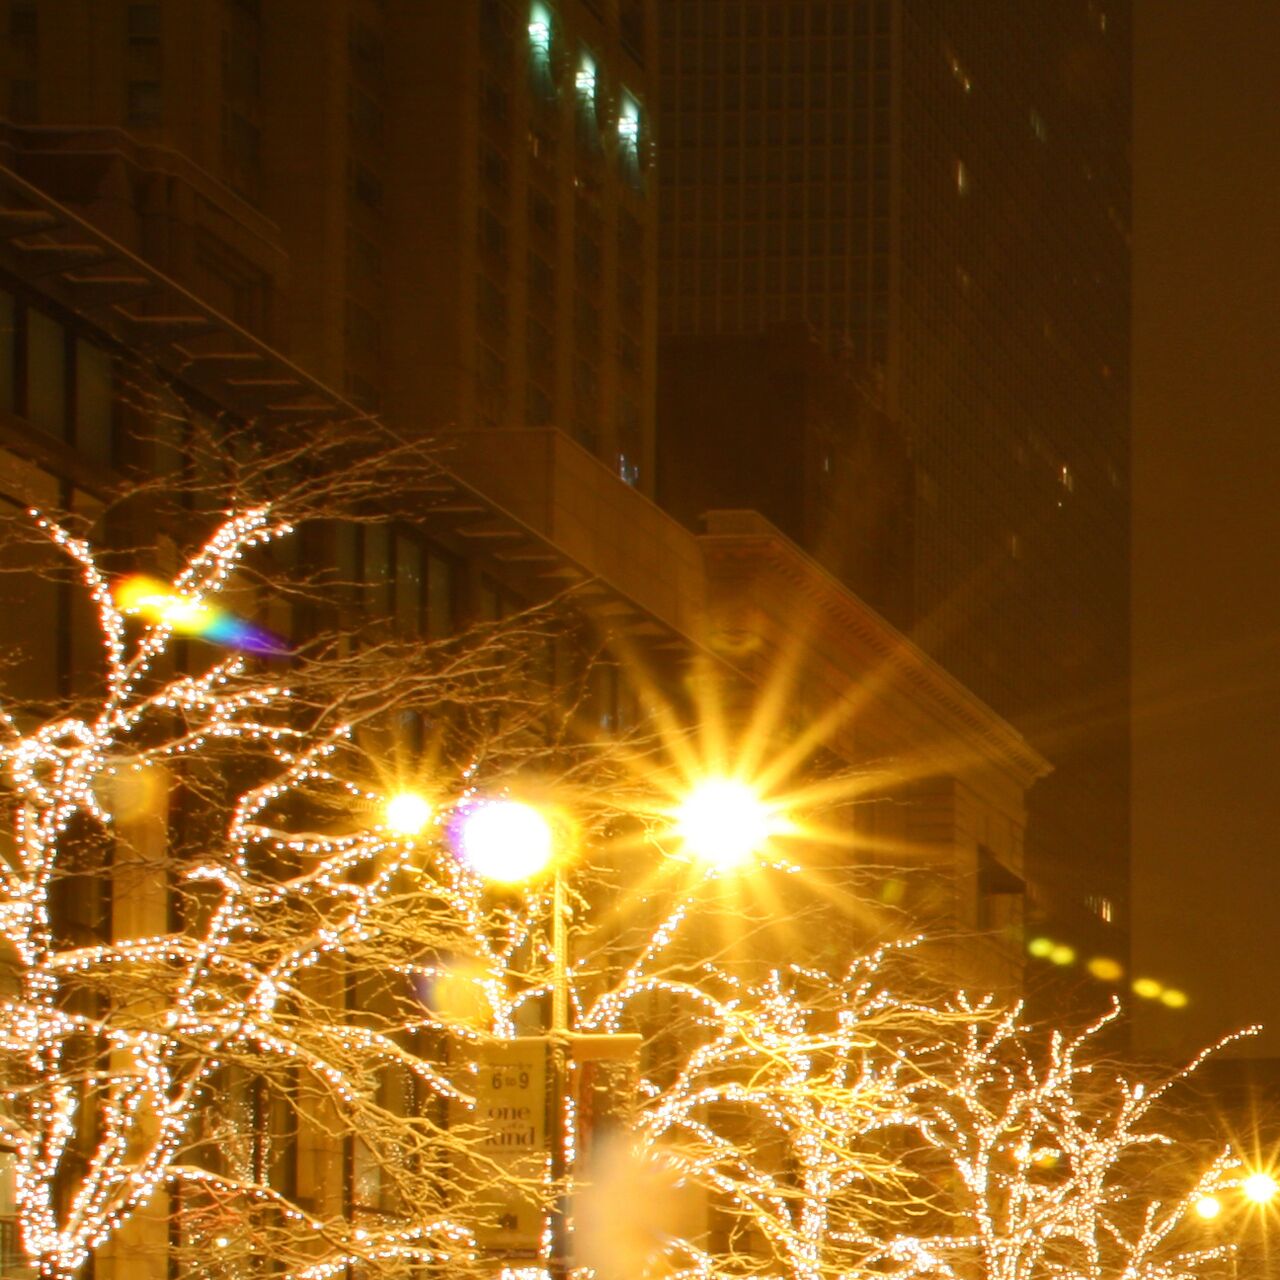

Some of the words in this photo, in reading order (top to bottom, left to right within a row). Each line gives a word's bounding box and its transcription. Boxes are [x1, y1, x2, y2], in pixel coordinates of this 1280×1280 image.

[492, 1072, 502, 1089] 6
[519, 1072, 529, 1089] 9
[488, 1107, 530, 1119] one
